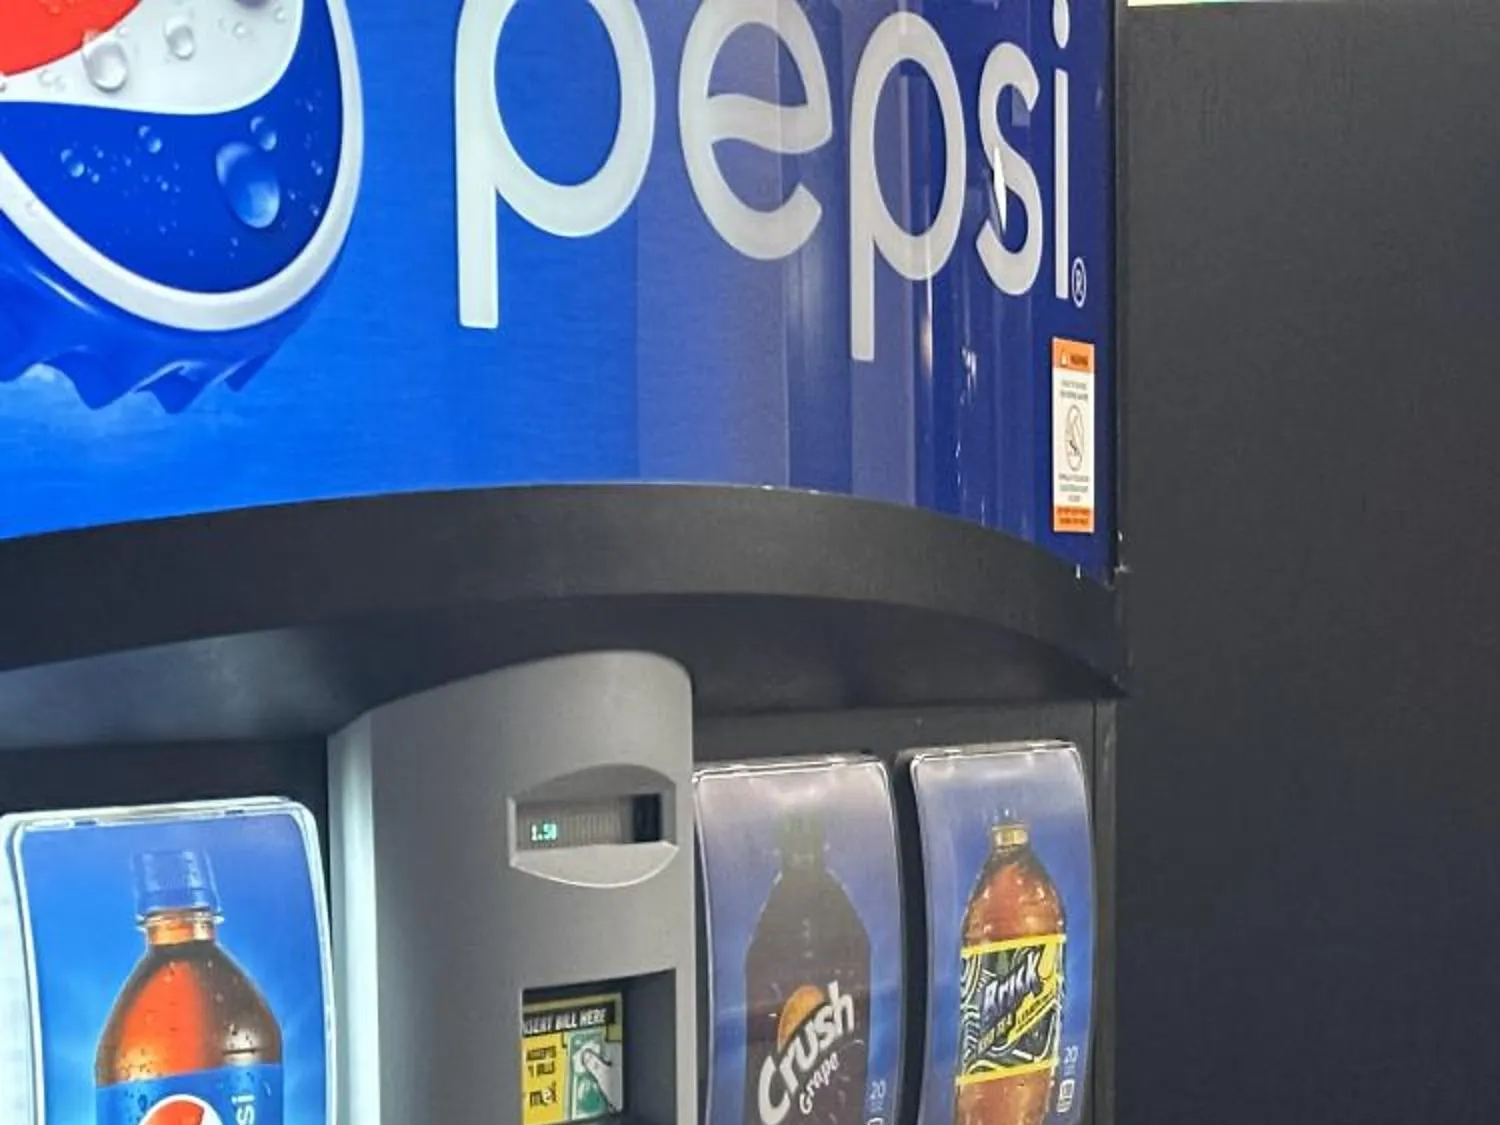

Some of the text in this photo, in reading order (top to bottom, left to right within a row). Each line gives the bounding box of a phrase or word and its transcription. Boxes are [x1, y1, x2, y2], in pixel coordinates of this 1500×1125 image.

[454, 0, 1073, 362] pepsi
[579, 1007, 607, 1027] HERE
[798, 1051, 841, 1116] Grape
